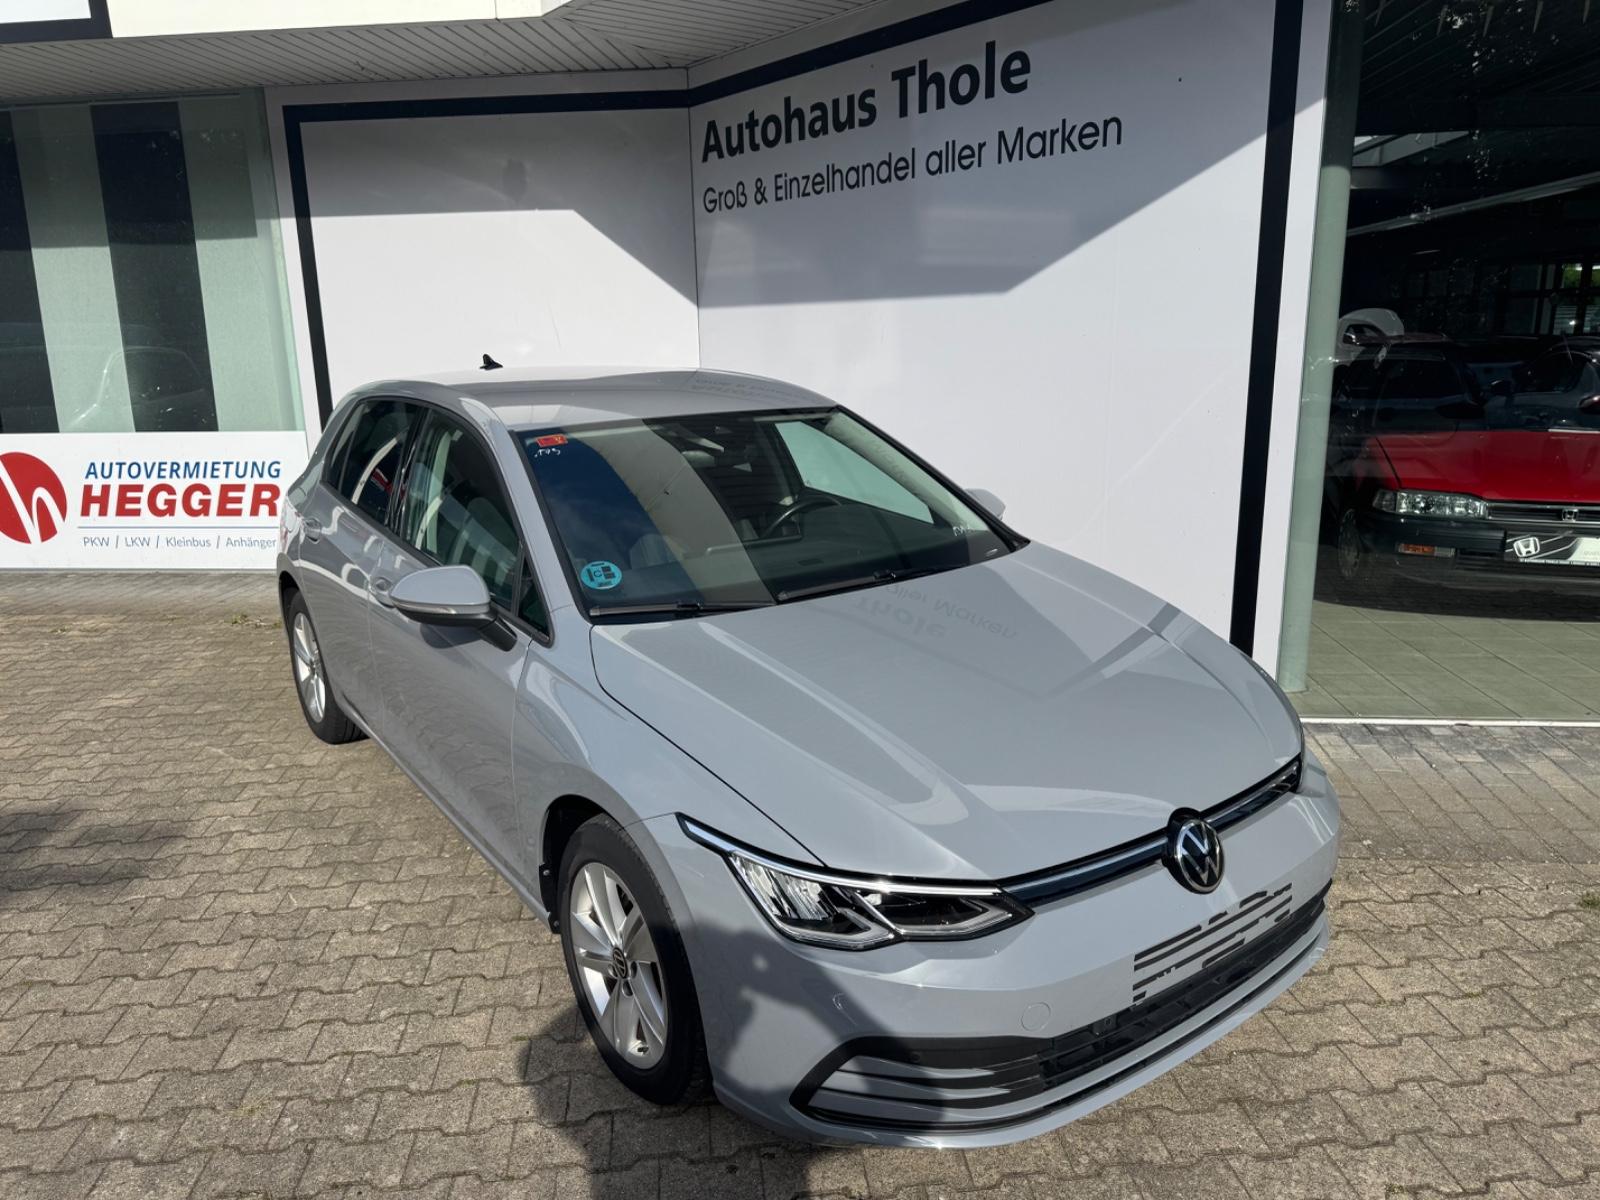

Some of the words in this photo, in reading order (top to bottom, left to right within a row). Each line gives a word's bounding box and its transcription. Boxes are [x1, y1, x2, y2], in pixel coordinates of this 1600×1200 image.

[701, 88, 878, 163] Autohaus
[890, 40, 1032, 119] Thole
[702, 181, 748, 214] Groß
[753, 177, 769, 205] &
[773, 147, 916, 202] Einzelhandel
[925, 139, 987, 177] aller
[996, 116, 1123, 165] Marken
[84, 460, 282, 480] AUTOVERMIETUNG
[80, 483, 282, 518] HEGGER
[83, 536, 110, 548] PKW
[125, 536, 150, 548] LKW
[165, 536, 212, 548] Kleinbus
[226, 535, 277, 551] Anhänger
